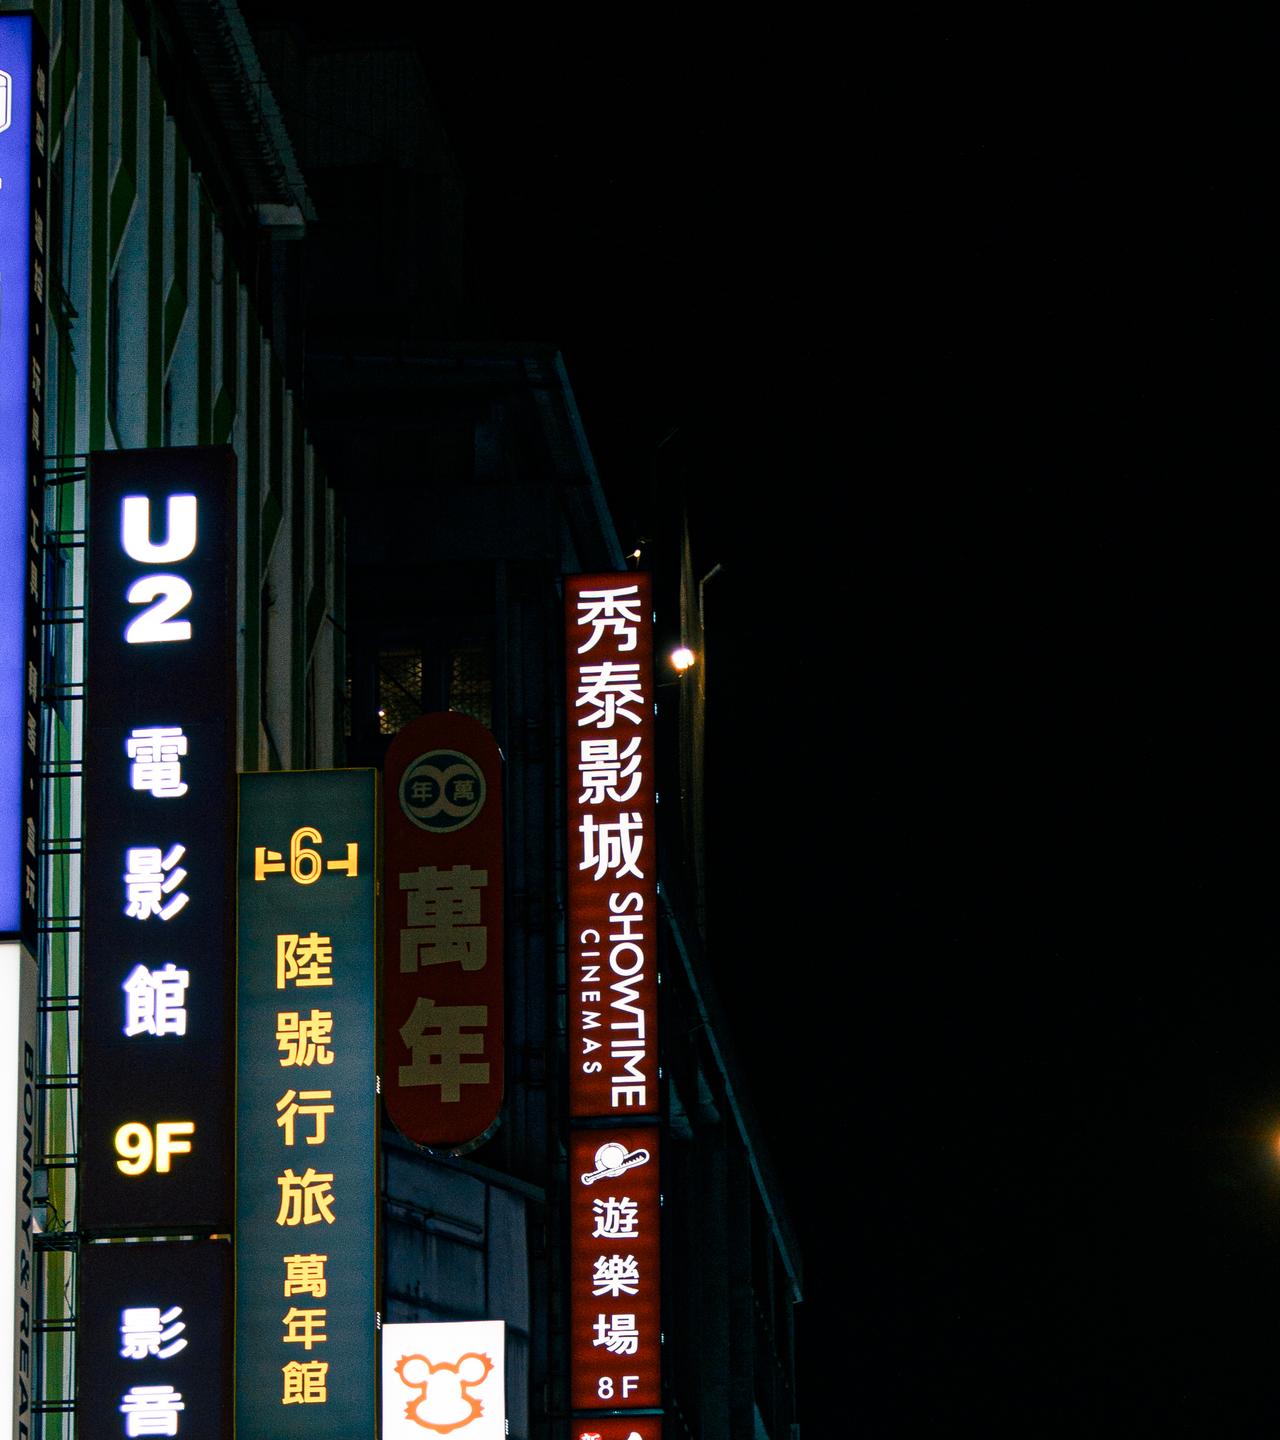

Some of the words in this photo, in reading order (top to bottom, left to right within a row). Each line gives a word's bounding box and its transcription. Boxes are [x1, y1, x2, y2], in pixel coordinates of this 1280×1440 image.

[575, 584, 645, 882] 秀泰影城
[122, 726, 190, 1037] 電影館
[397, 864, 490, 1103] 萬年
[275, 932, 336, 1228] 陸號行旅
[581, 928, 602, 1075] CINEMAS
[609, 892, 647, 1108] SHOWTIME
[115, 1122, 195, 1176] 9F
[281, 1254, 329, 1406] 萬年館
[592, 1196, 640, 1355] 遊樂場
